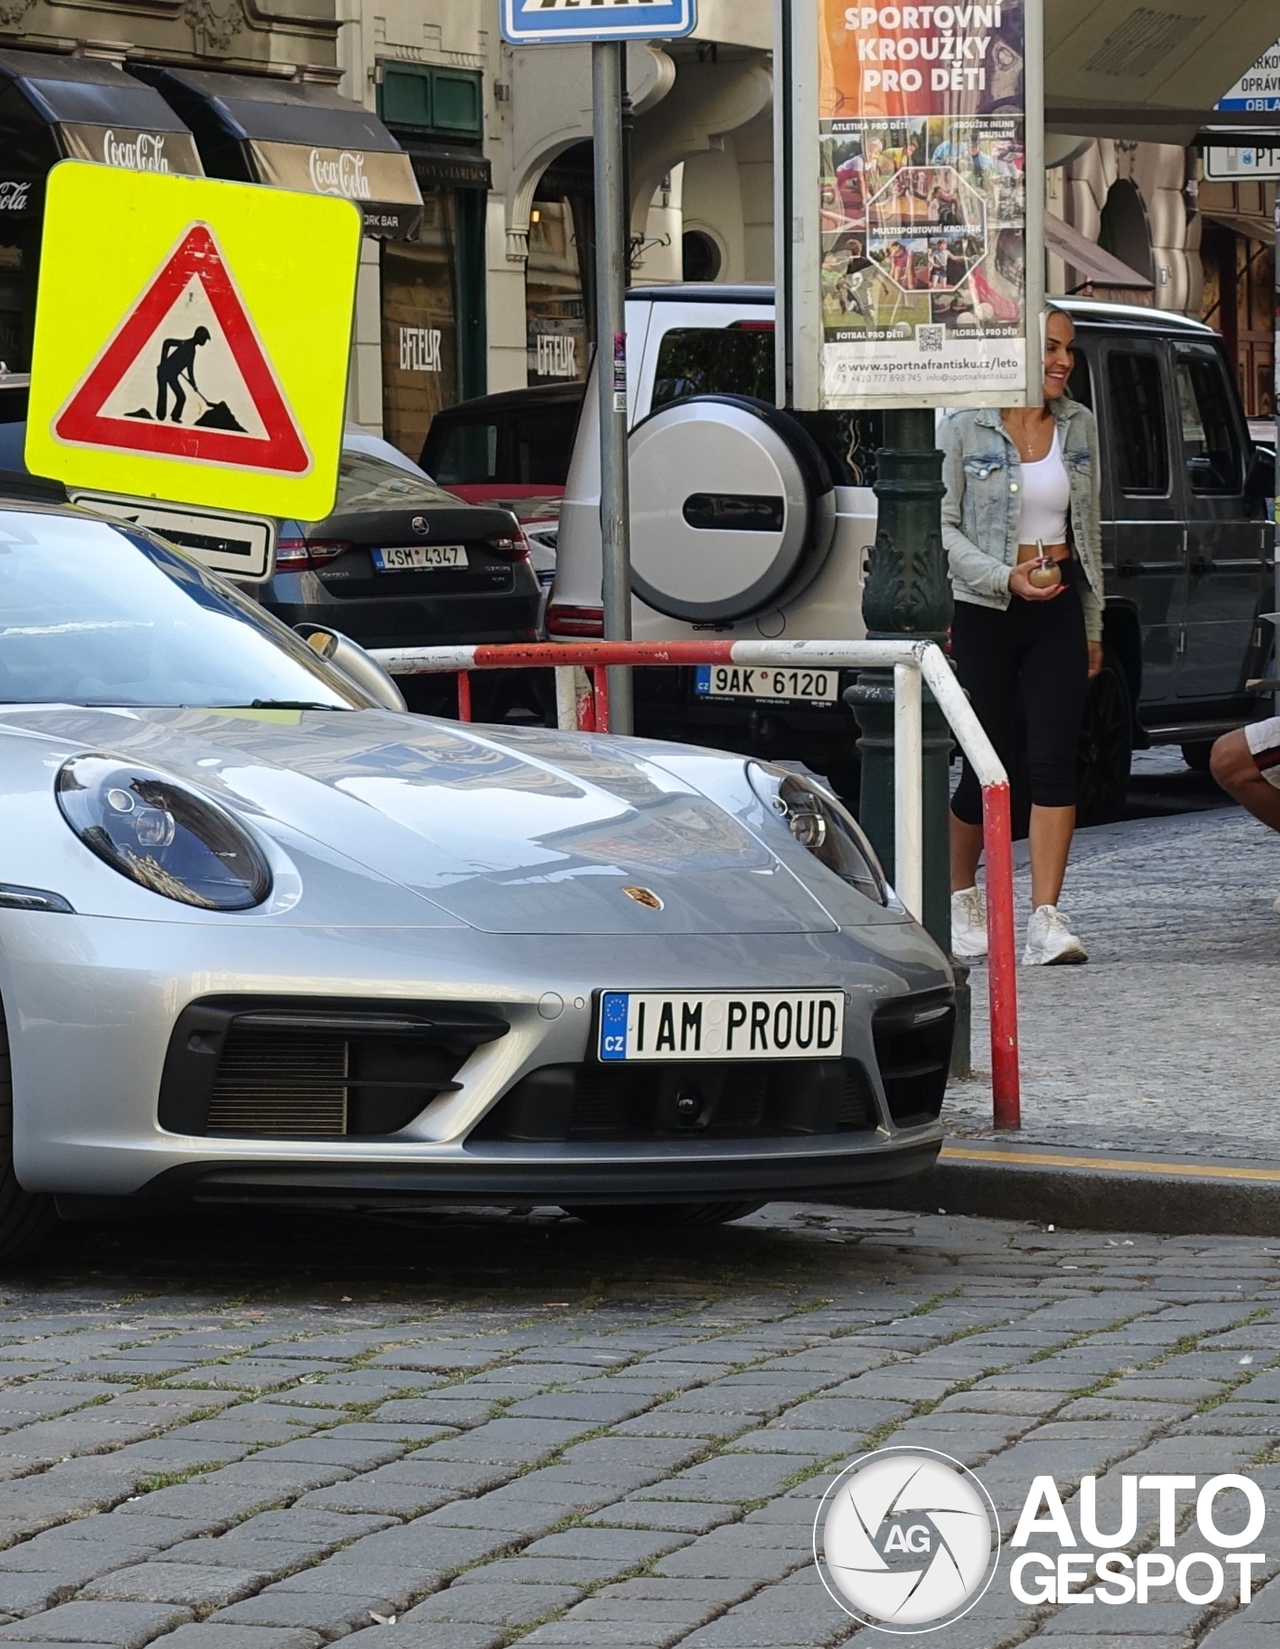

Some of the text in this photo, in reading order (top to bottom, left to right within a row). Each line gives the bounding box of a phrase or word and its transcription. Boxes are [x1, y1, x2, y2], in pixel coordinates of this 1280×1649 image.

[844, 0, 1003, 30] SPORTOVNÍ
[858, 29, 992, 61] KROUŽKY
[1252, 55, 1280, 70] RKO
[863, 61, 986, 92] PRO DĚTI
[832, 120, 908, 131] ATLETIKA PRO DĚTI
[363, 214, 399, 227] ORK BAR
[872, 224, 943, 235] MULTISPORTOVNÍ
[836, 331, 867, 340] FOTBAL
[868, 331, 885, 339] PRO
[985, 328, 1001, 336] PRO
[848, 357, 1019, 374] www.sportnafrantisku.cz/leto
[872, 373, 887, 382] 777
[387, 548, 415, 566] 4SM
[425, 547, 459, 564] 4347
[698, 668, 828, 697] CZ 9AK 6120
[604, 999, 837, 1052] CZ I AM PROUD
